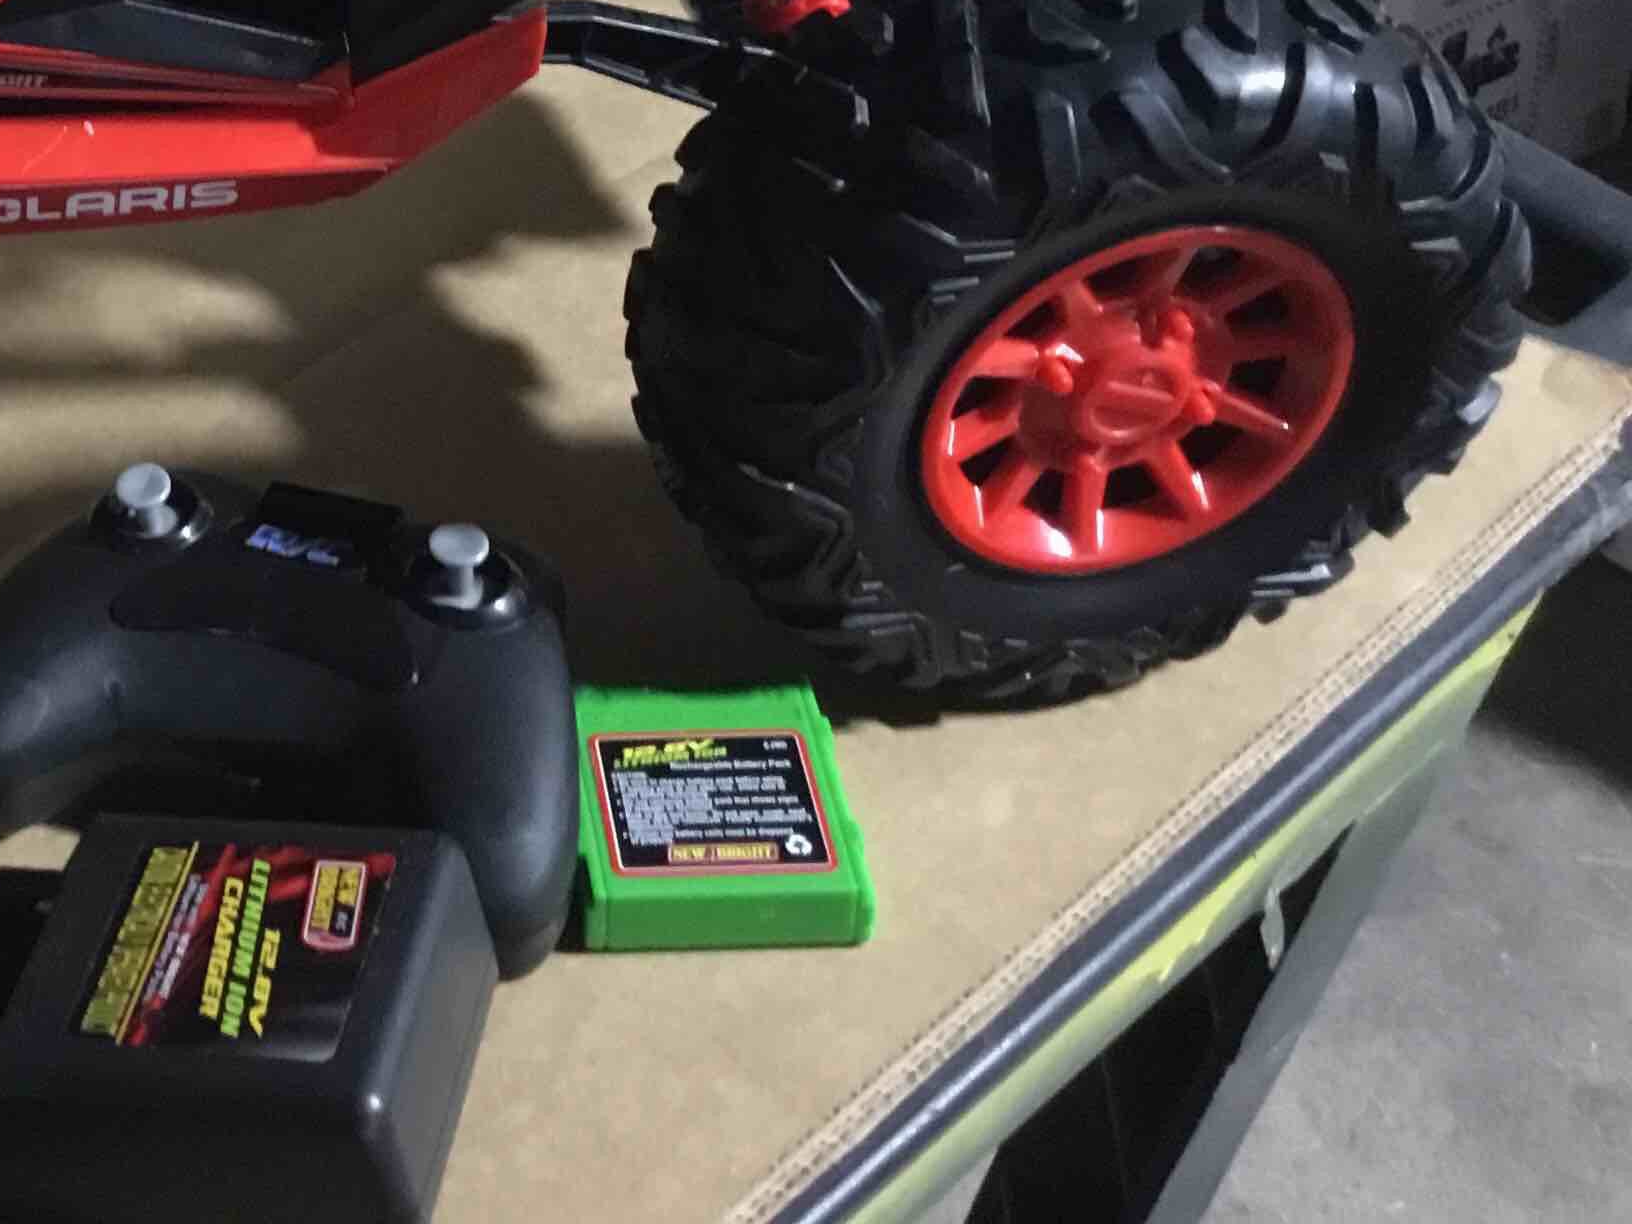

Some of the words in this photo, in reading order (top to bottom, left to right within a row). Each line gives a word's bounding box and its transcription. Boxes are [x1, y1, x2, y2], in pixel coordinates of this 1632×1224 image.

[200, 876, 244, 1020] CHARGER
[232, 858, 271, 978] LITHIUM
[220, 981, 247, 1038] ION
